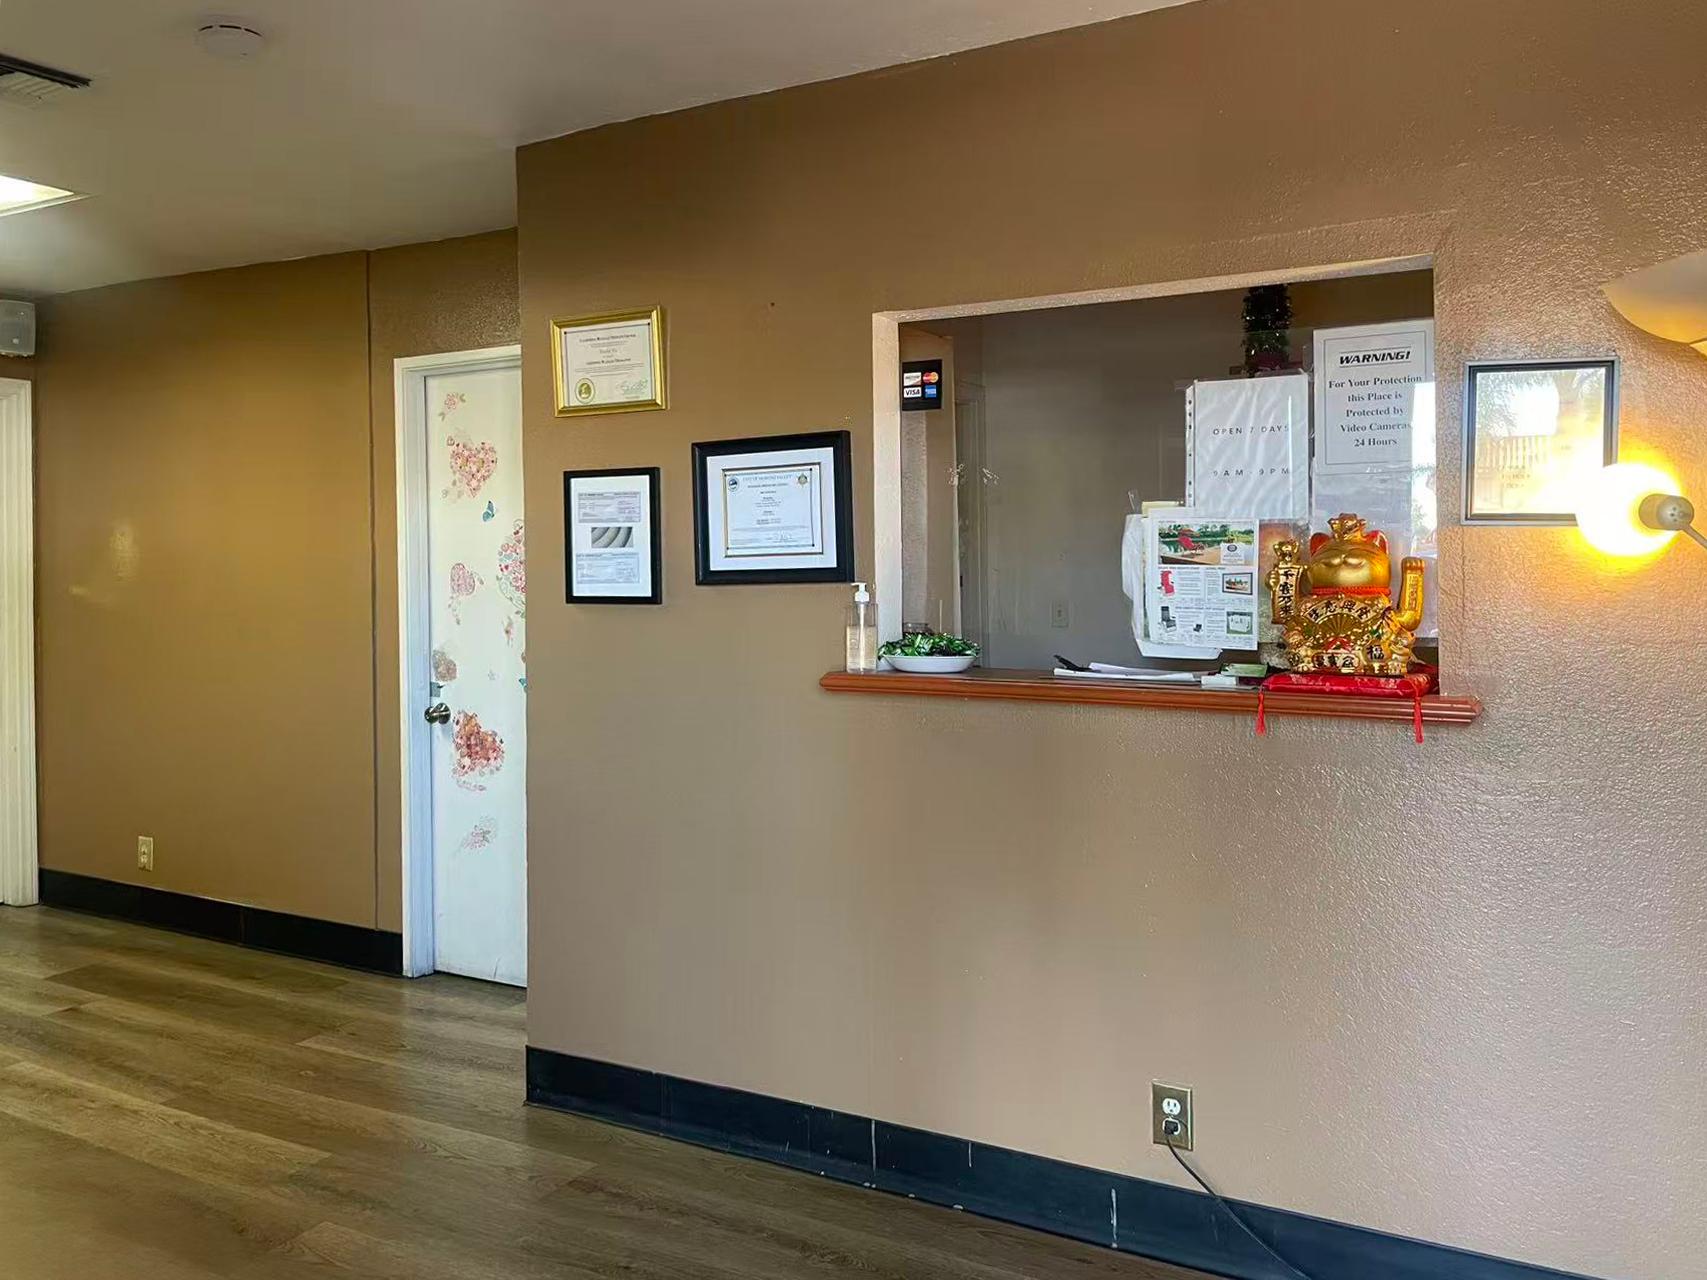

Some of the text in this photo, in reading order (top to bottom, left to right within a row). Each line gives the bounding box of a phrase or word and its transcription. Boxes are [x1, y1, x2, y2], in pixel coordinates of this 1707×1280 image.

[1339, 351, 1411, 365] WARNING!
[1328, 374, 1422, 389] For Your Protection
[905, 388, 920, 396] VISA
[1347, 390, 1403, 402] this Place is
[1346, 406, 1404, 417] Protected by
[1213, 427, 1243, 436] OPEN
[1260, 425, 1290, 434] DAYS
[1340, 420, 1412, 433] Video Cameras
[1354, 437, 1398, 447] 24 Hours
